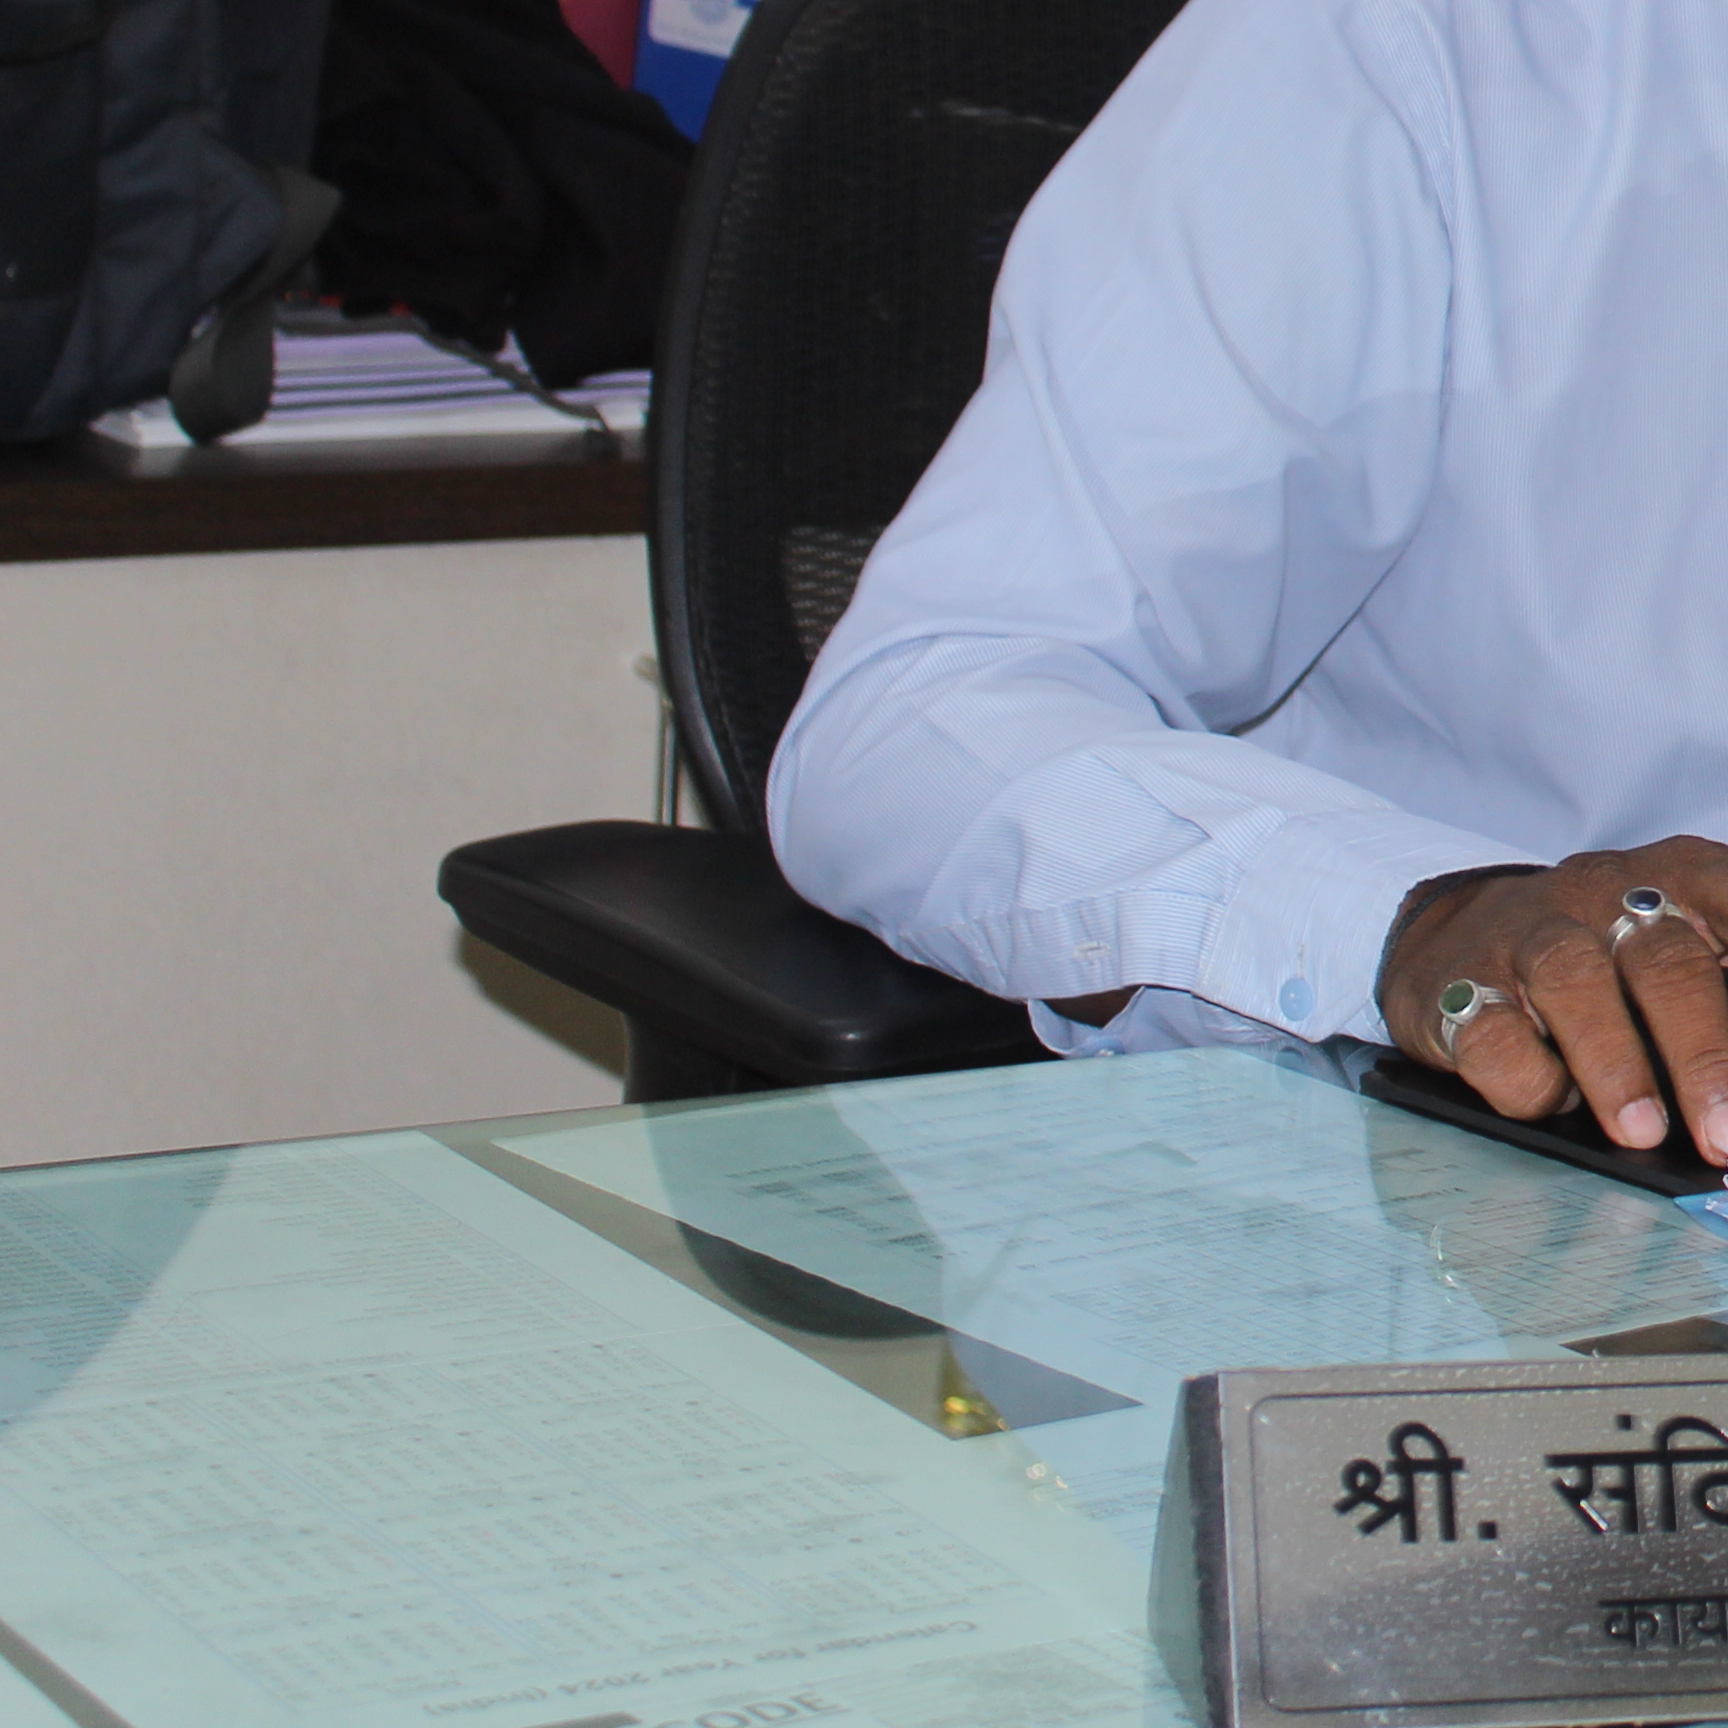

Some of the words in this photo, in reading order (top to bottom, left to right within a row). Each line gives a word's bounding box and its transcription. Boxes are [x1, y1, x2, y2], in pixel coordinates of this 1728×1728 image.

[1333, 1421, 1498, 1543] श्री.
[815, 1621, 978, 1653] Calendar
[661, 1657, 746, 1678] Year
[752, 1647, 807, 1664] for
[555, 1671, 651, 1697] 2024
